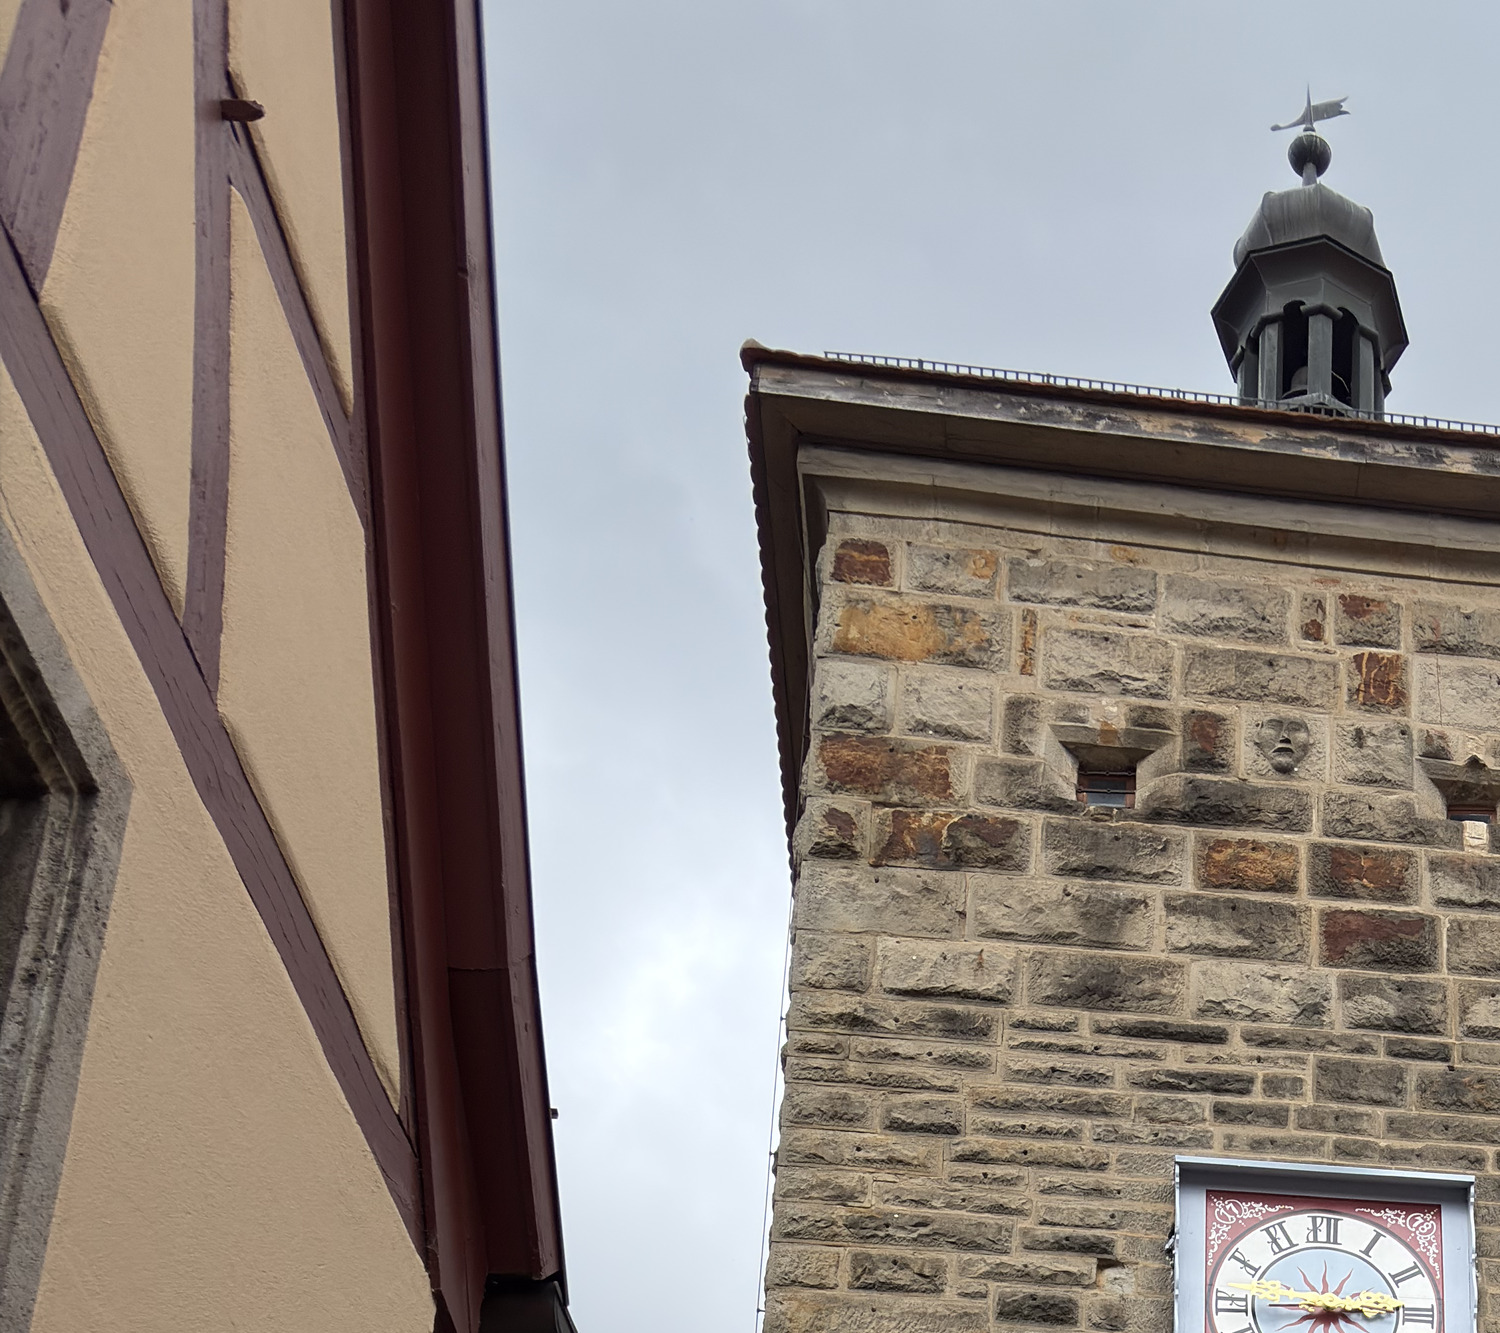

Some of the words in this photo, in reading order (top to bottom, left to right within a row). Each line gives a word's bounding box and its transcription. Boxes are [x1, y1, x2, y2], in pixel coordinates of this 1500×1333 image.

[1260, 1221, 1299, 1255] XI
[1305, 1216, 1343, 1245] XII
[1359, 1229, 1386, 1258] I
[1228, 1248, 1262, 1278] X
[1388, 1261, 1425, 1288] II
[1216, 1288, 1248, 1316] IX
[1401, 1303, 1434, 1330] III
